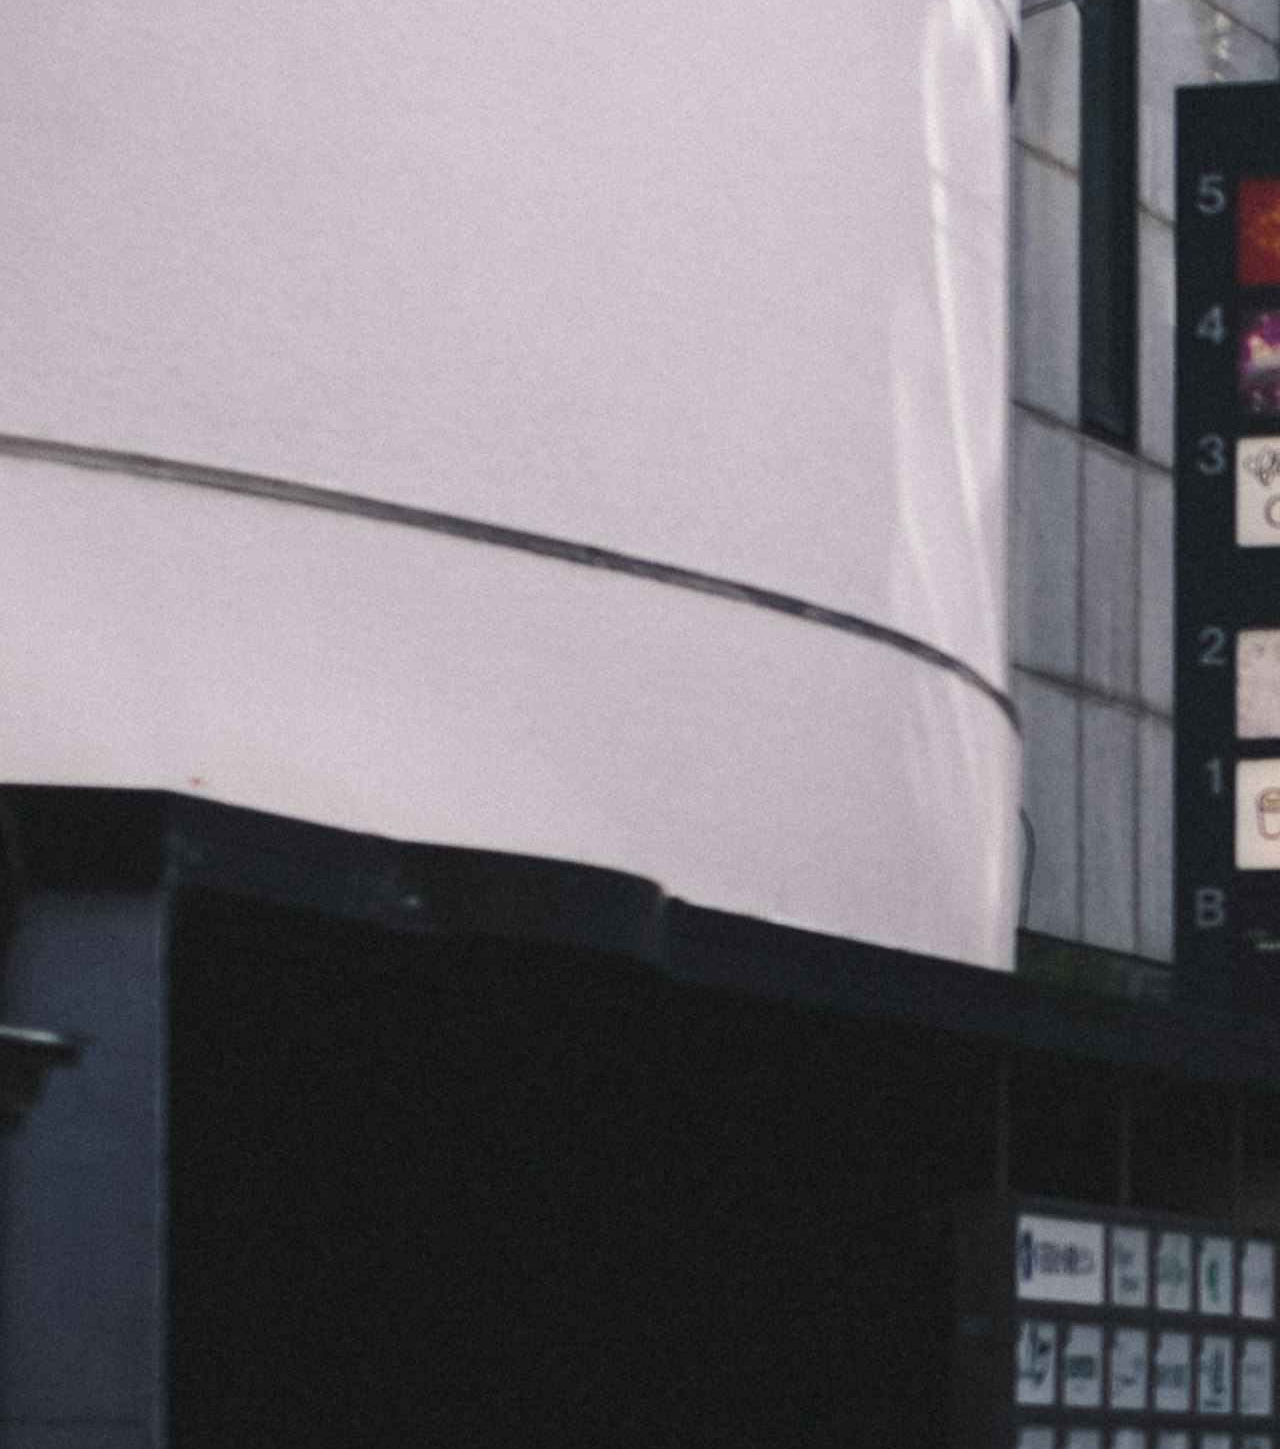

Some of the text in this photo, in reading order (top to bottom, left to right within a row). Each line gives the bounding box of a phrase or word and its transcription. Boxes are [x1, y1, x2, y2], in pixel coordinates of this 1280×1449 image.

[1196, 174, 1227, 216] 5
[1195, 306, 1227, 346] 4
[1198, 434, 1227, 475] 3
[1201, 627, 1226, 668] 2
[1204, 758, 1225, 796] 1
[1193, 887, 1227, 929] B
